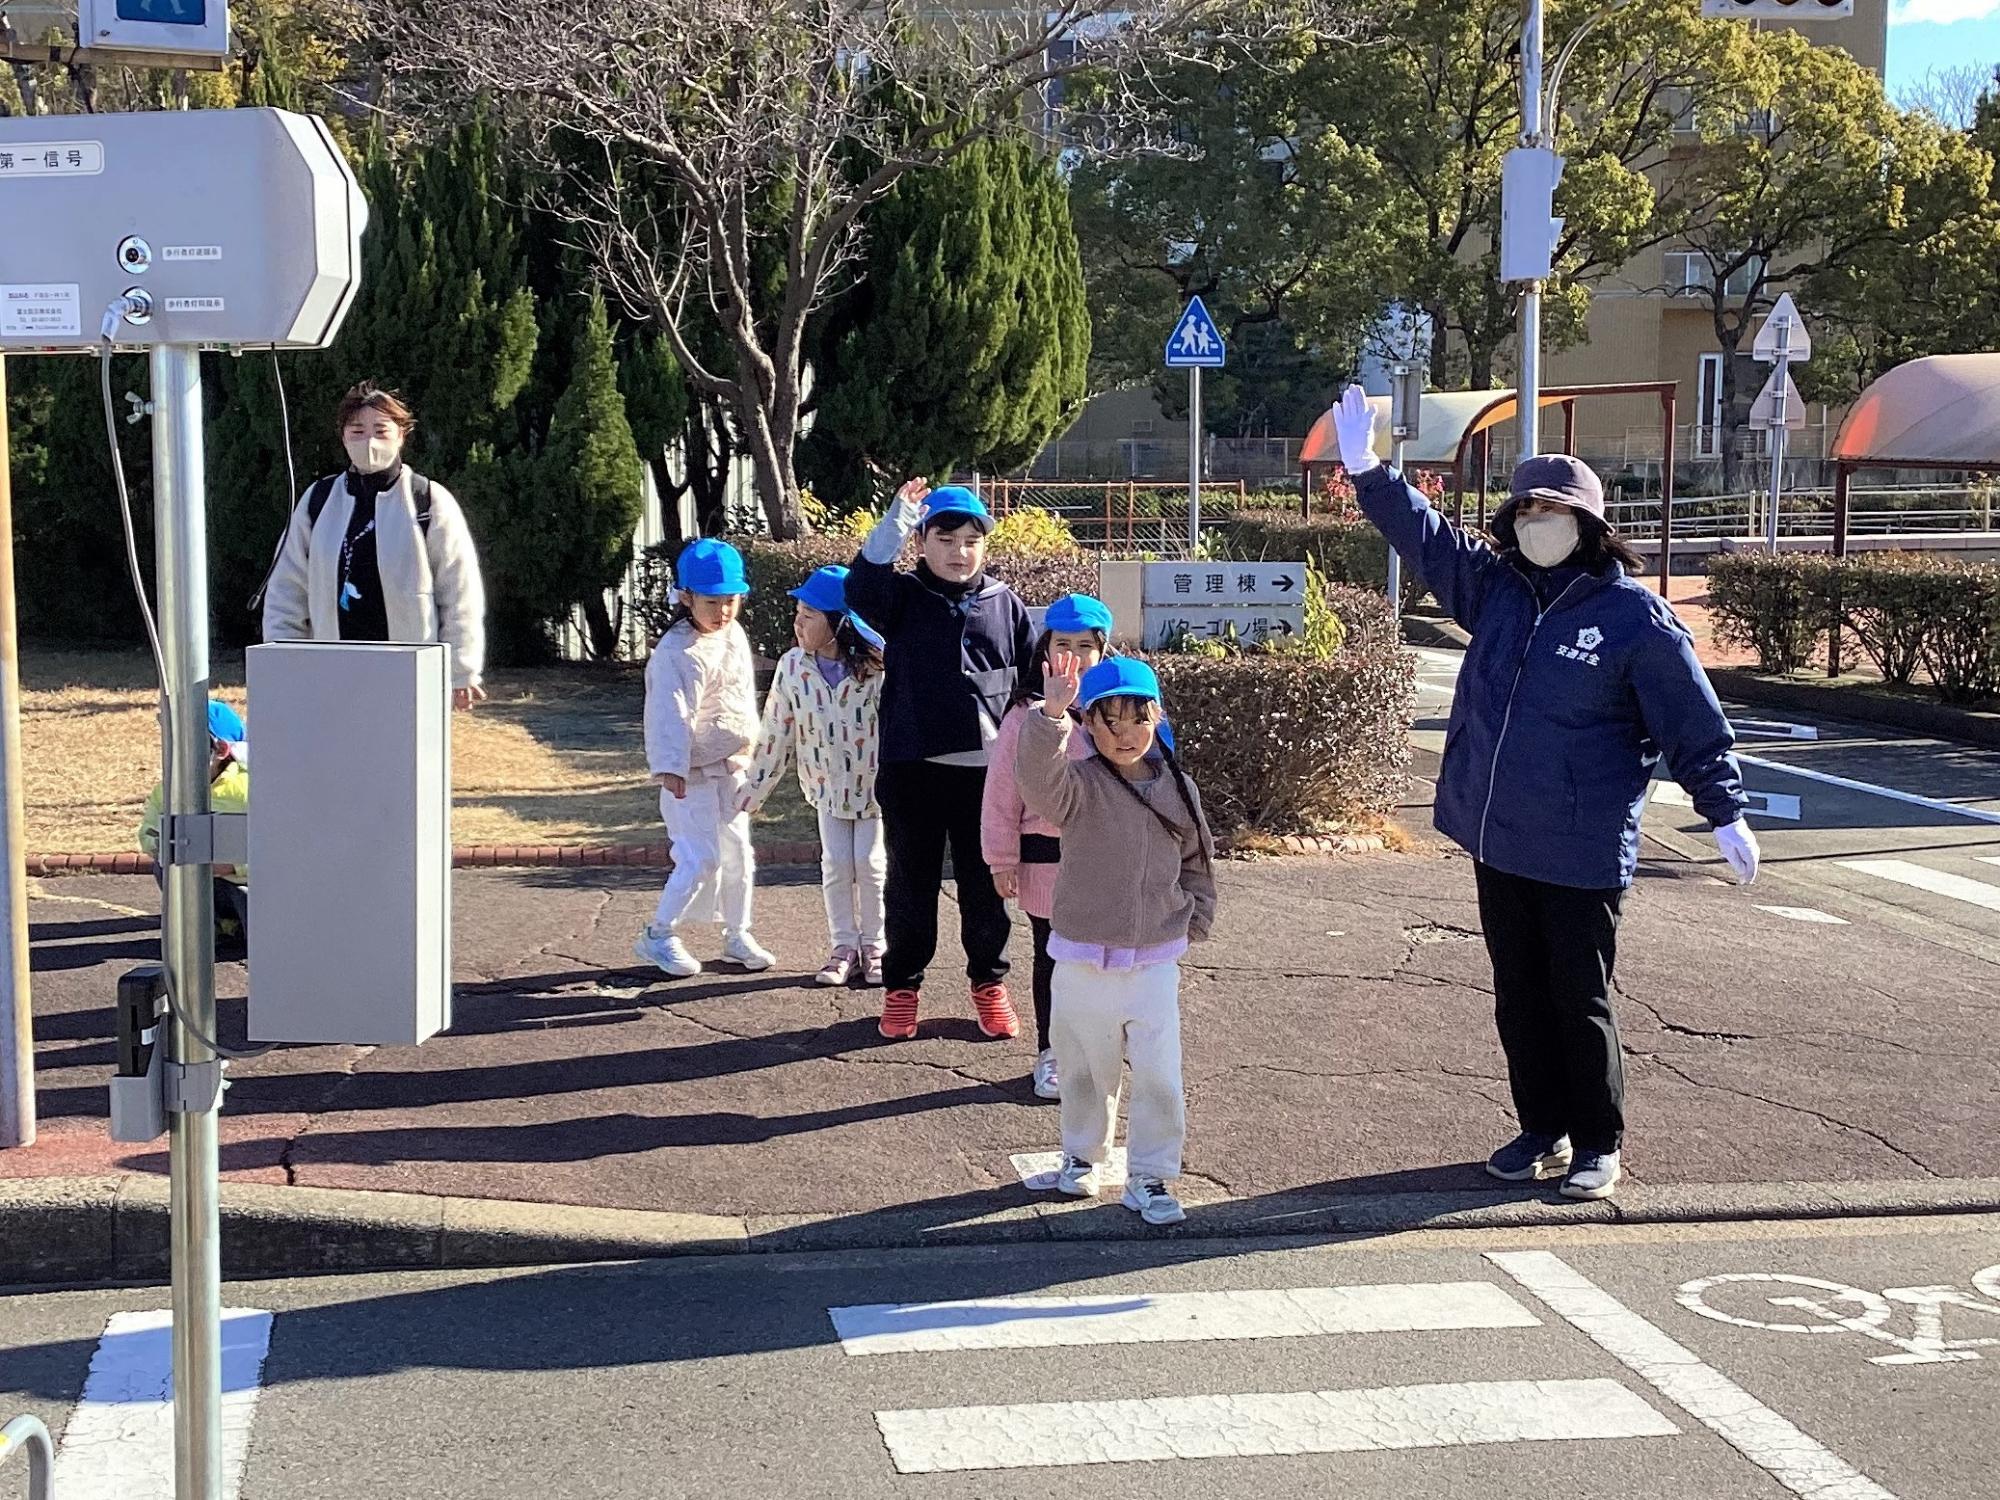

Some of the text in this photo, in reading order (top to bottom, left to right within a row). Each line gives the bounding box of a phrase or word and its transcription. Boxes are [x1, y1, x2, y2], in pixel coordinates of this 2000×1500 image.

[1173, 573, 1256, 593] 管理棟
[1556, 644, 1600, 666] 交通安全
